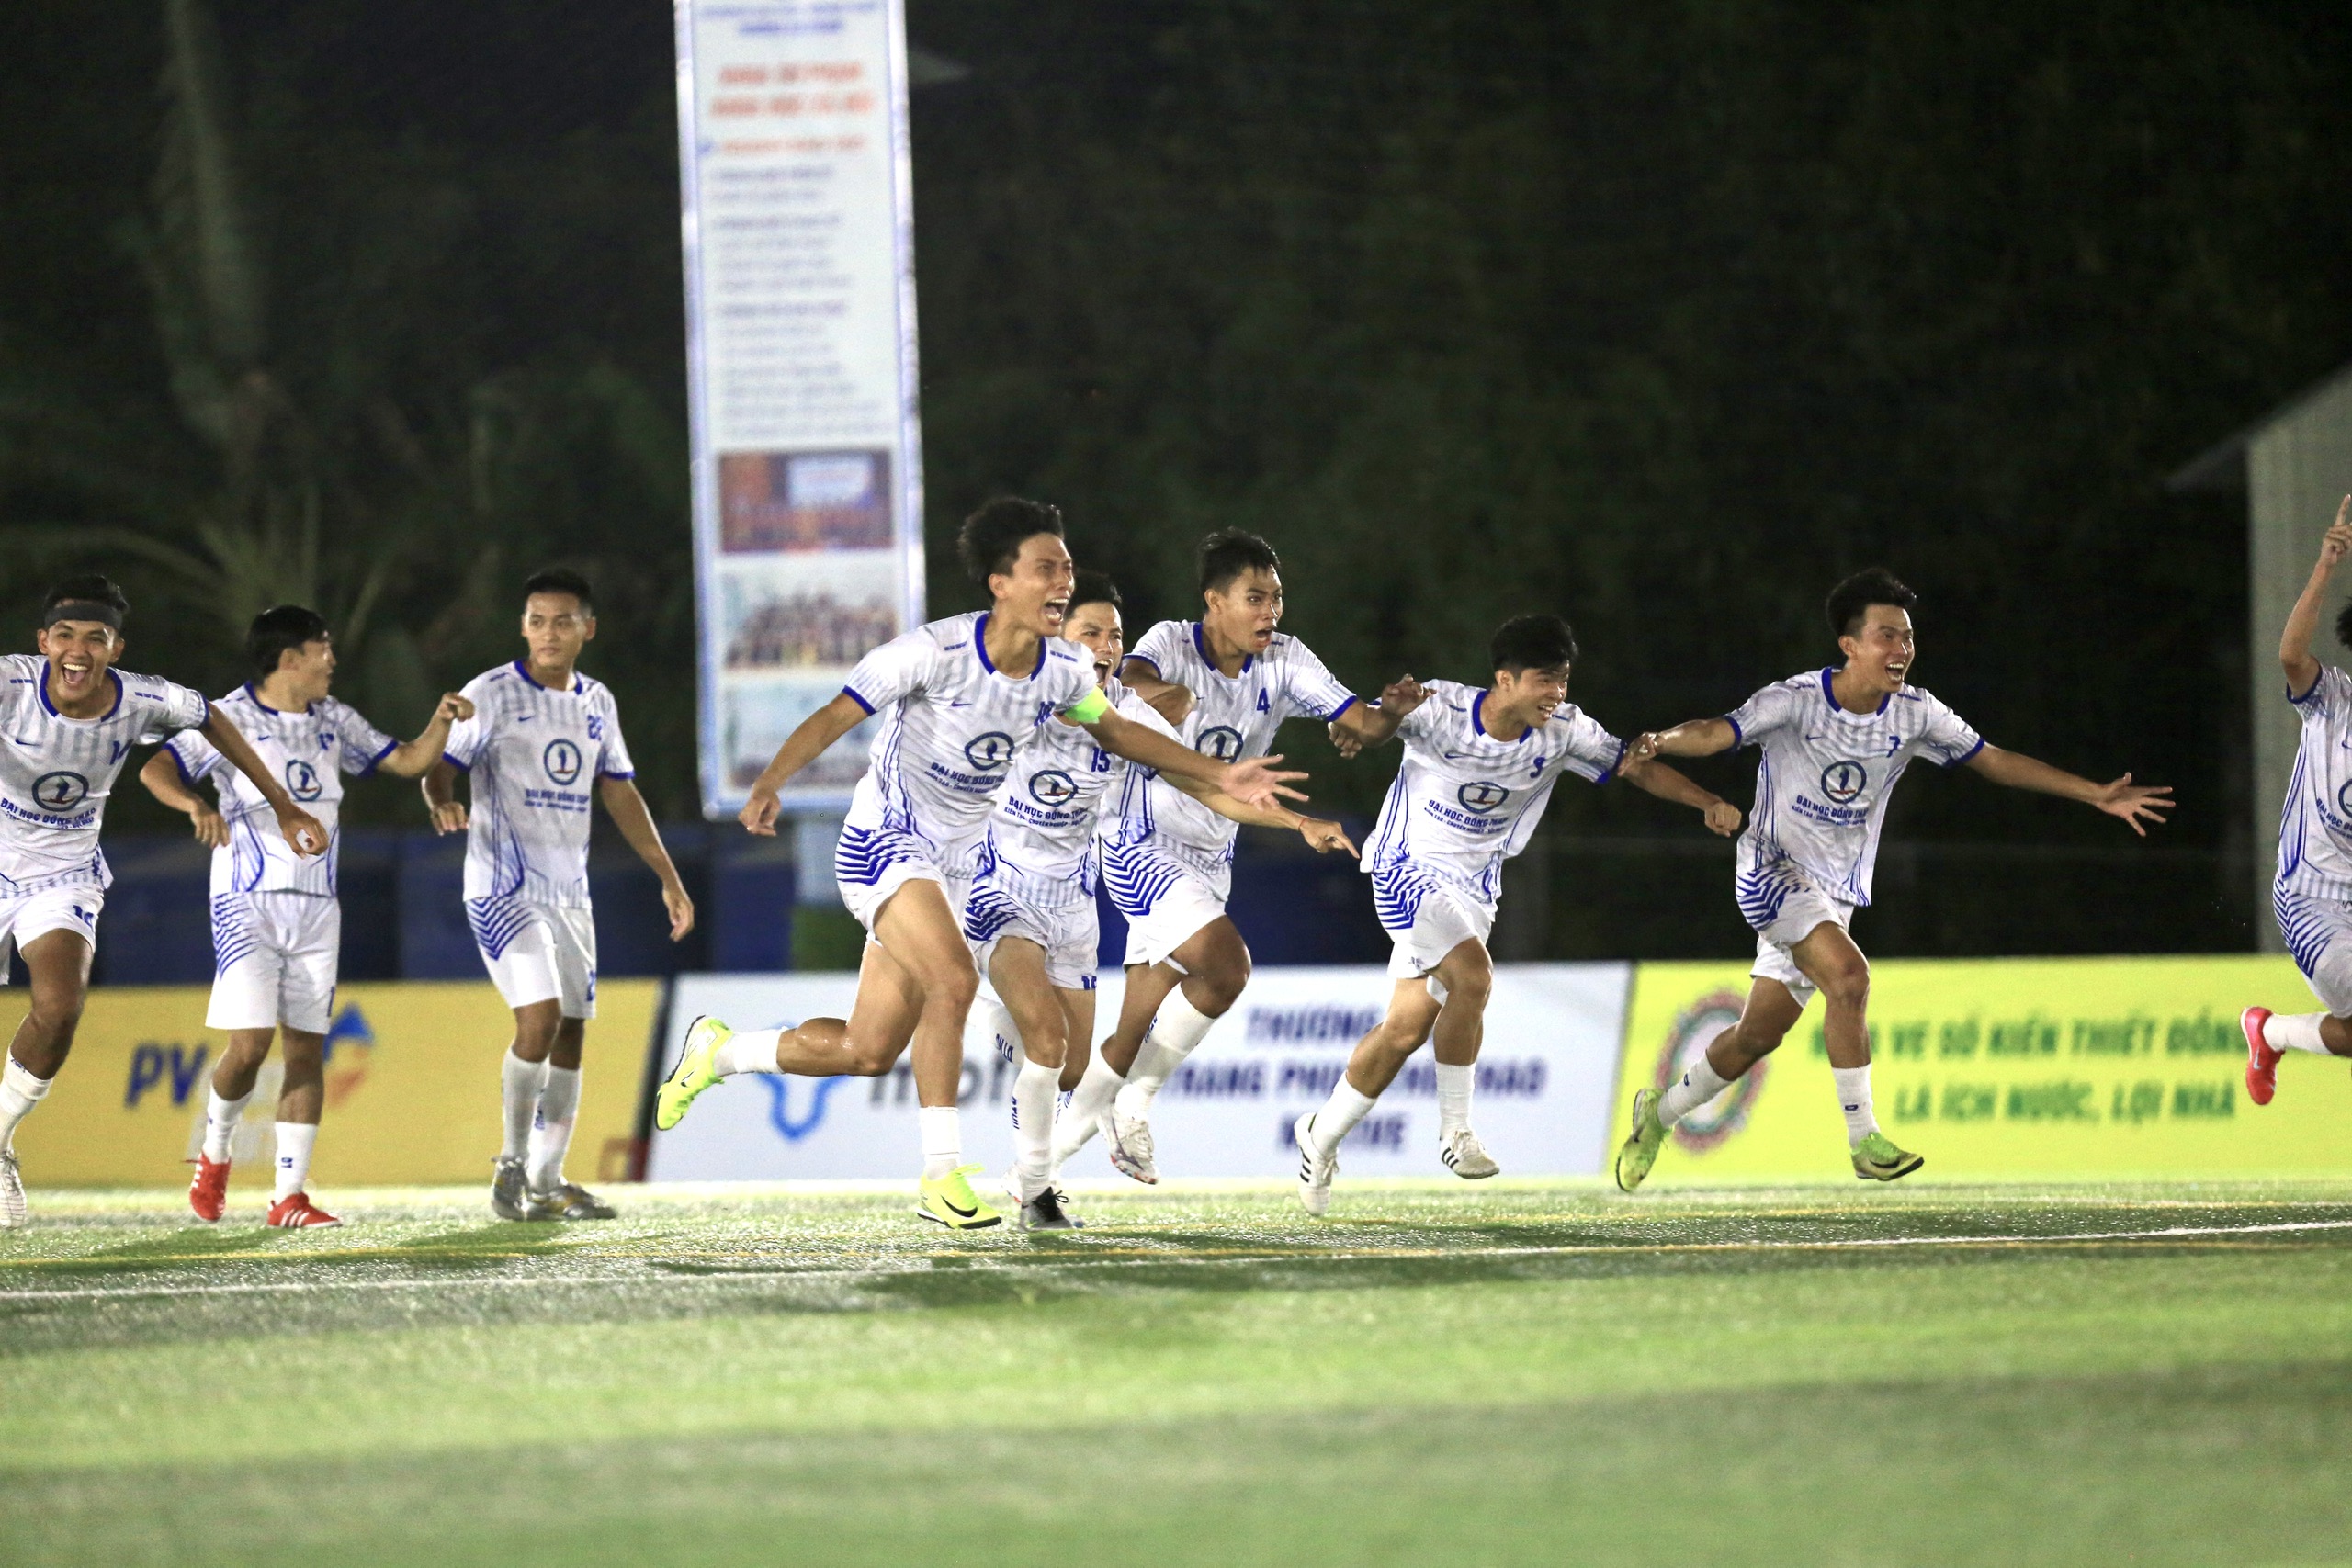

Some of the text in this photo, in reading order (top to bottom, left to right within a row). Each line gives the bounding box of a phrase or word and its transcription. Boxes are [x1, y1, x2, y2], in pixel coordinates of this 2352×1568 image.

[1256, 687, 1270, 715] 4
[1886, 735, 1901, 758] 7
[1091, 747, 1111, 773] 15
[1530, 756, 1545, 779] 9
